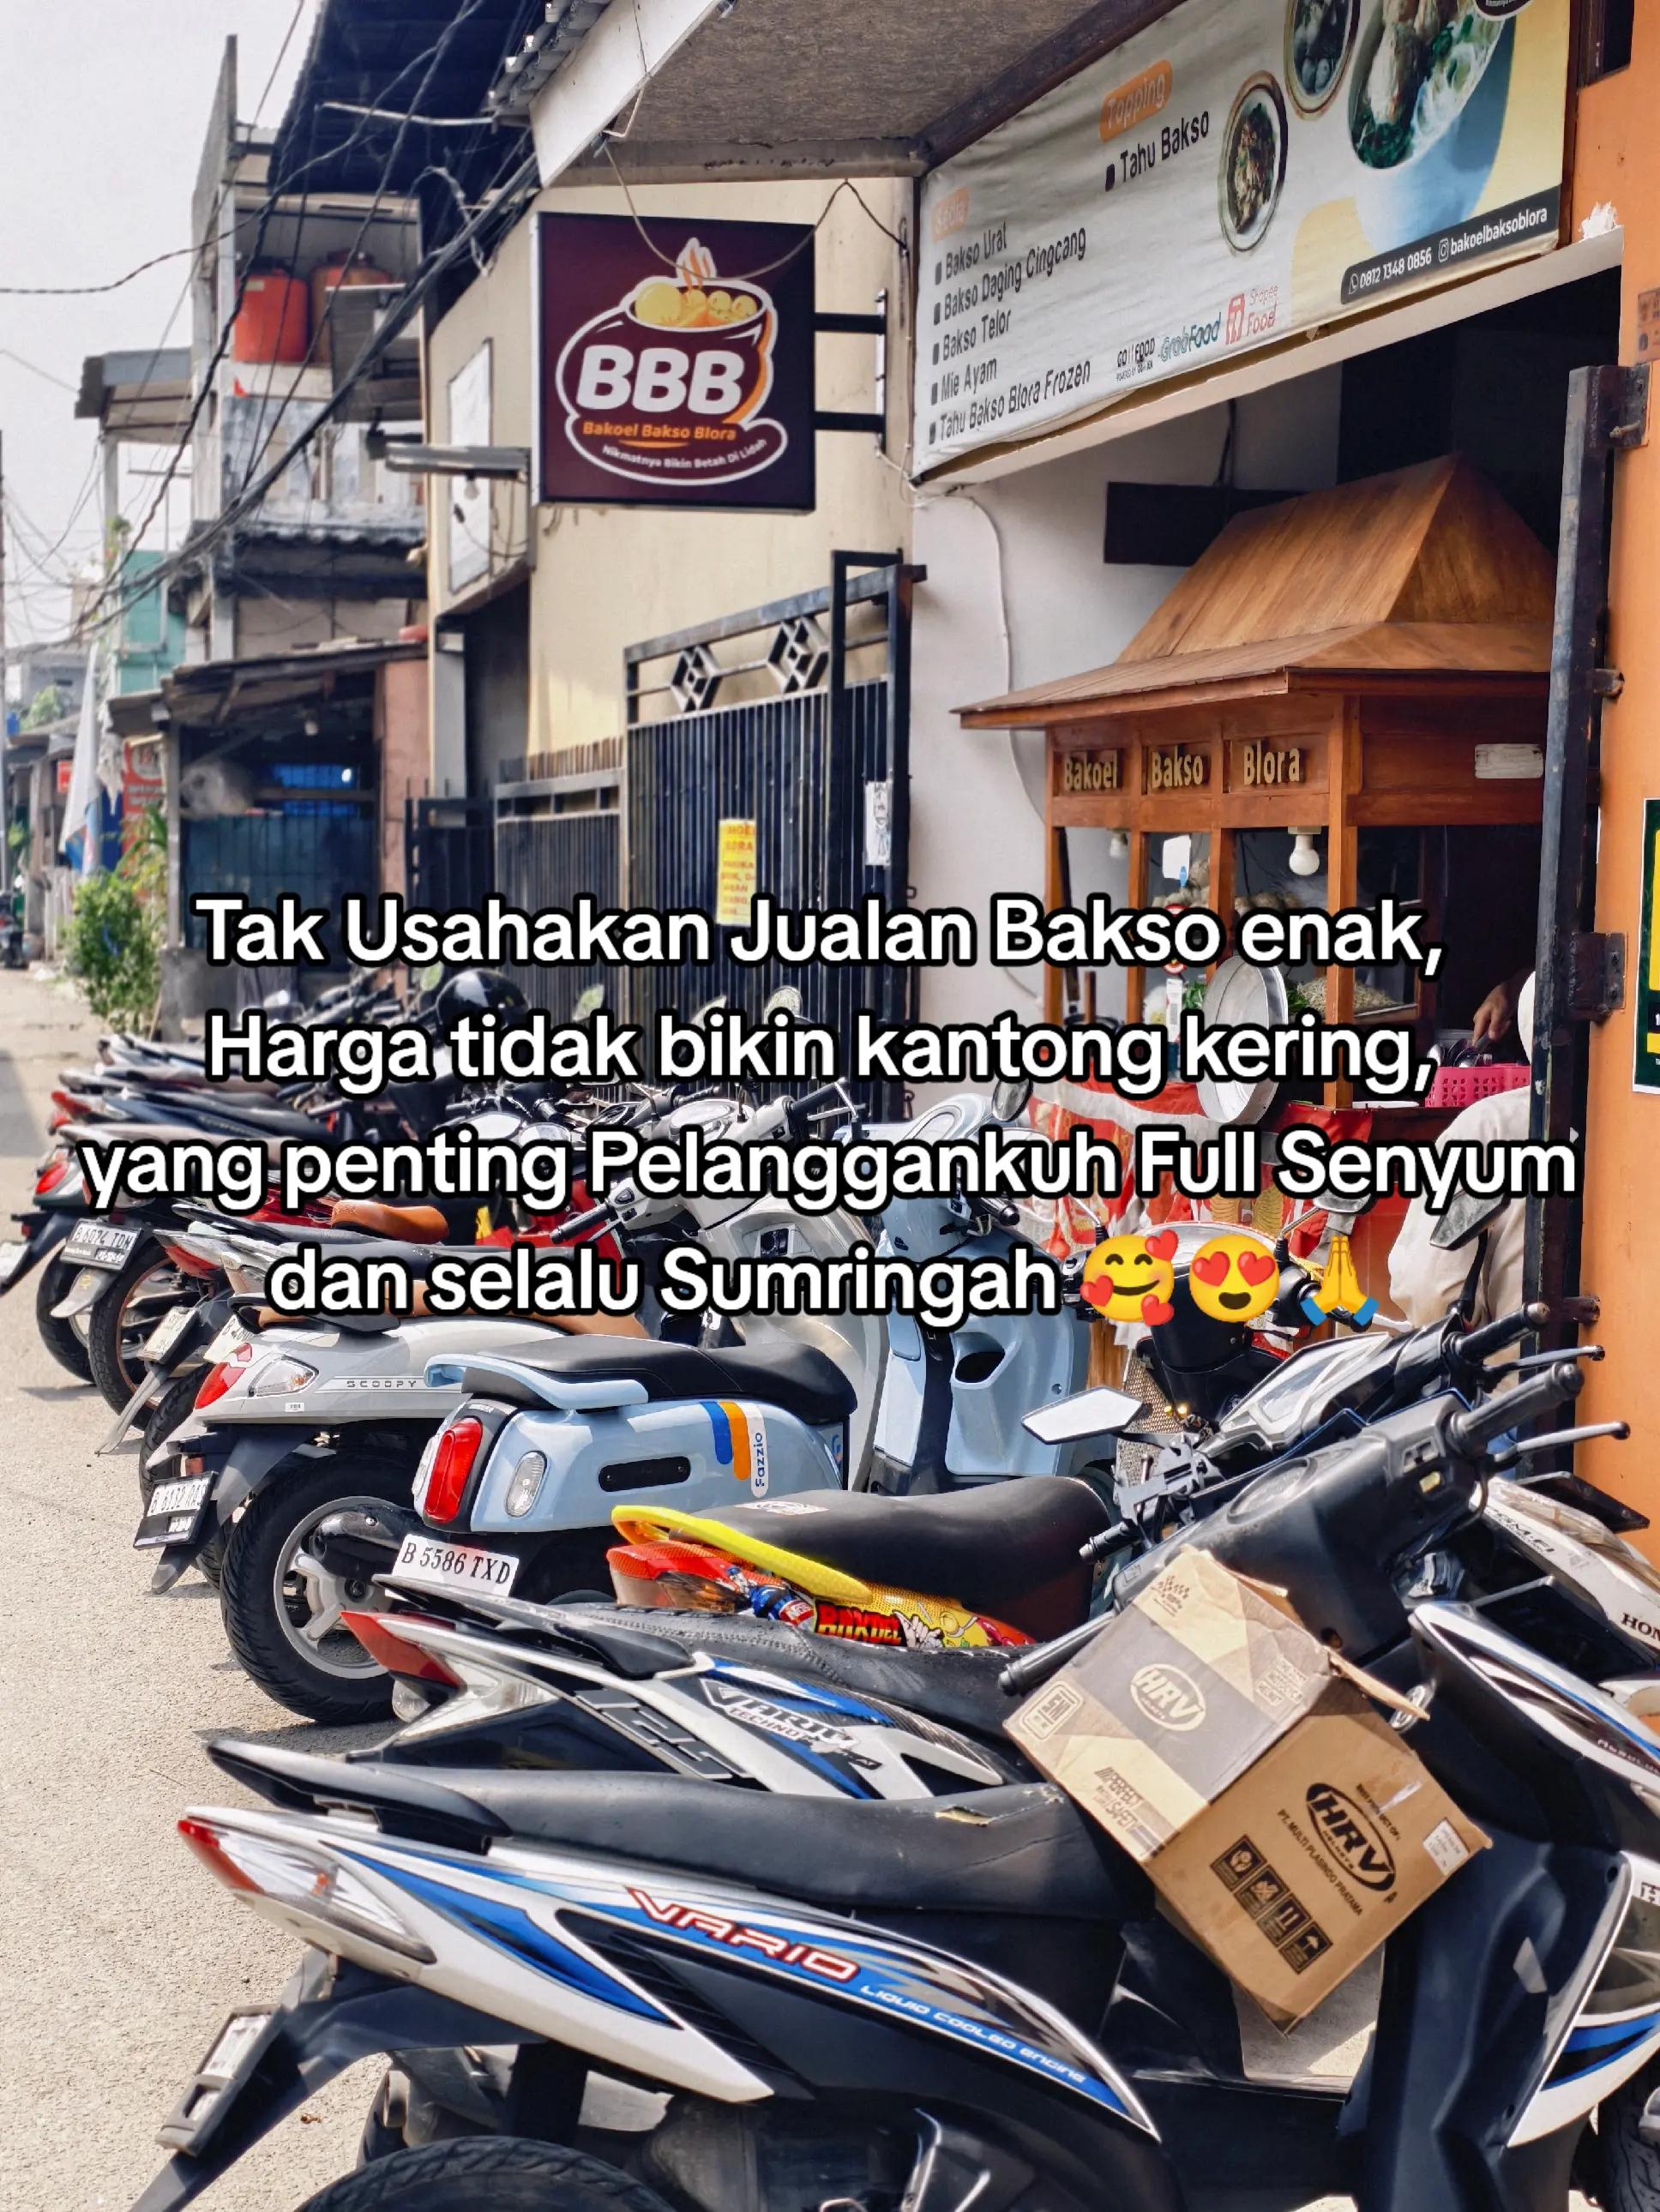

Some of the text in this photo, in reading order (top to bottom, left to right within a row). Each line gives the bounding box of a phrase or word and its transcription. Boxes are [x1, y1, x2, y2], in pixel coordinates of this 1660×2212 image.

[1106, 73, 1166, 129] Topping
[1120, 110, 1210, 183] Tahu Bakso
[1450, 207, 1549, 255] bakoelbaksoblora
[944, 227, 1086, 321] Bakso Daging Cingcang
[946, 243, 980, 280] Bakso
[1382, 258, 1405, 280] 1348
[1407, 246, 1433, 271] 0856
[942, 309, 1012, 361] Bakso Telor
[576, 344, 745, 414] BBB
[940, 360, 1091, 441] Tahu Bakso Blora Frozen
[941, 358, 997, 402] Mie Ayam
[582, 421, 737, 441] Bakoel Bakso Blora
[663, 457, 693, 468] Bikin
[1063, 739, 1301, 791] Bakoel Bakso Blora
[346, 1379, 417, 1388] SCOOPY
[753, 1432, 766, 1488] Fazzio
[401, 1542, 511, 1584] B 5586 TXD
[1134, 1668, 1203, 1718] HRV
[1309, 1794, 1392, 1872] HRV
[1287, 1821, 1310, 1848] MULTI
[1334, 1880, 1364, 1916] PRATAMA
[623, 1884, 861, 1983] VARIO
[860, 1983, 932, 2017] LIQUID
